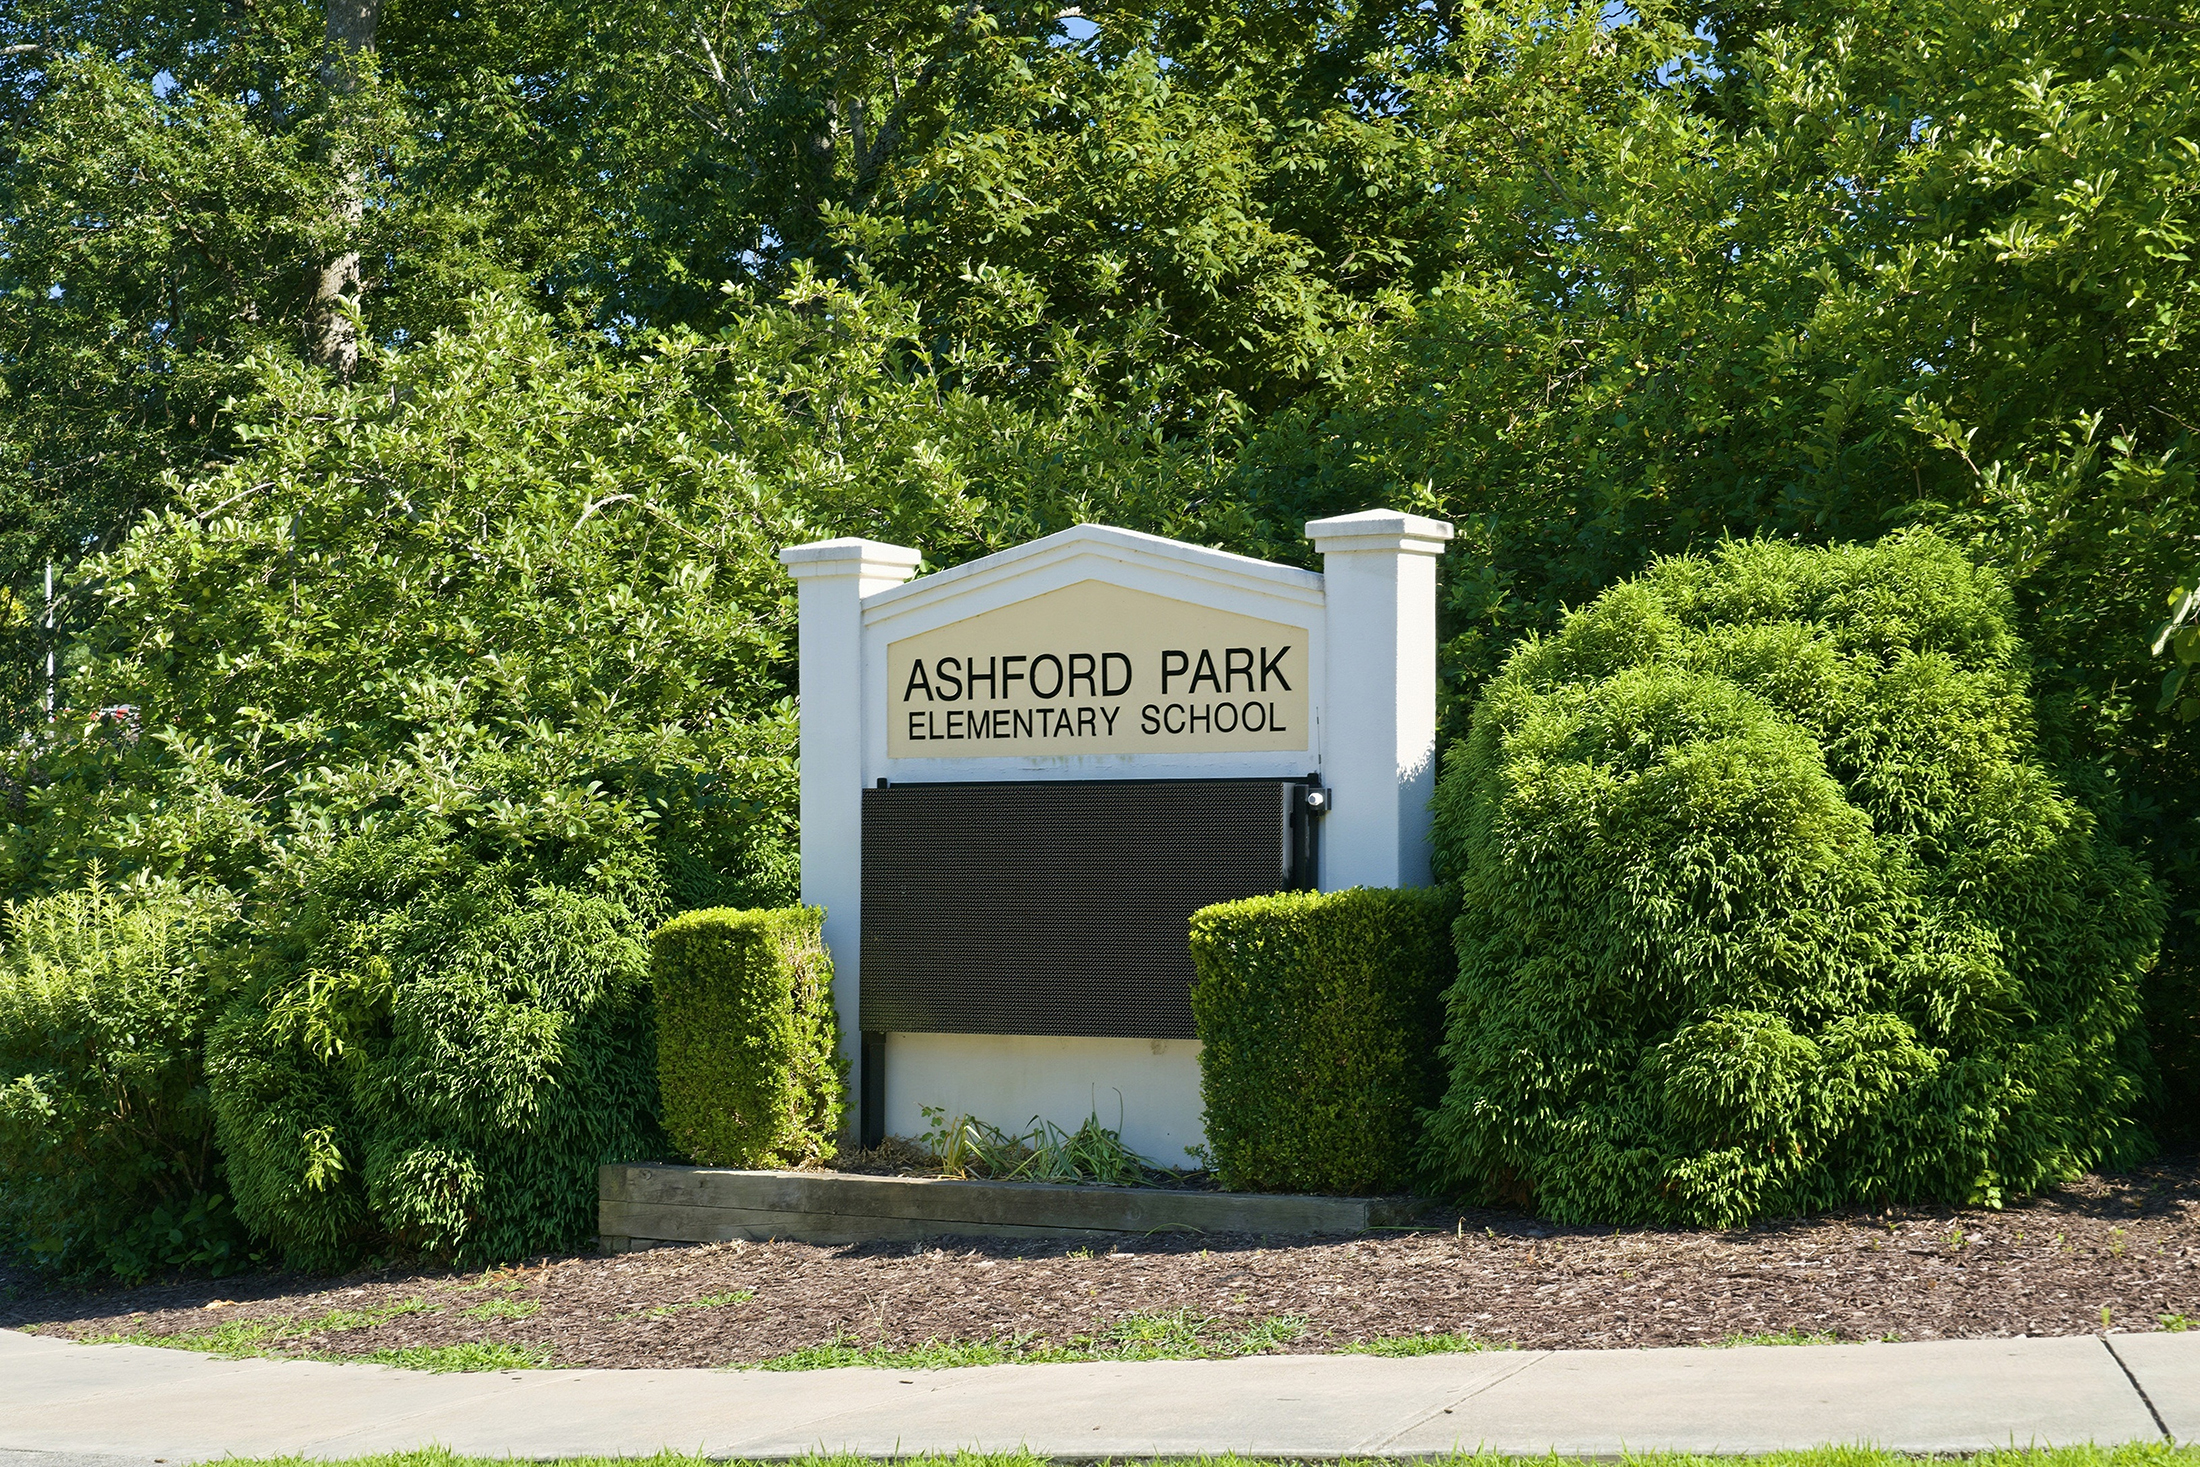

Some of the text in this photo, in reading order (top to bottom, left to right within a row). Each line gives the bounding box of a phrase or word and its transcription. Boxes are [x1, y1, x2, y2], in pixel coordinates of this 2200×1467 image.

[902, 645, 1293, 702] ASHFORD PARK
[908, 701, 1287, 741] ELEMENTARY SCHOOL
